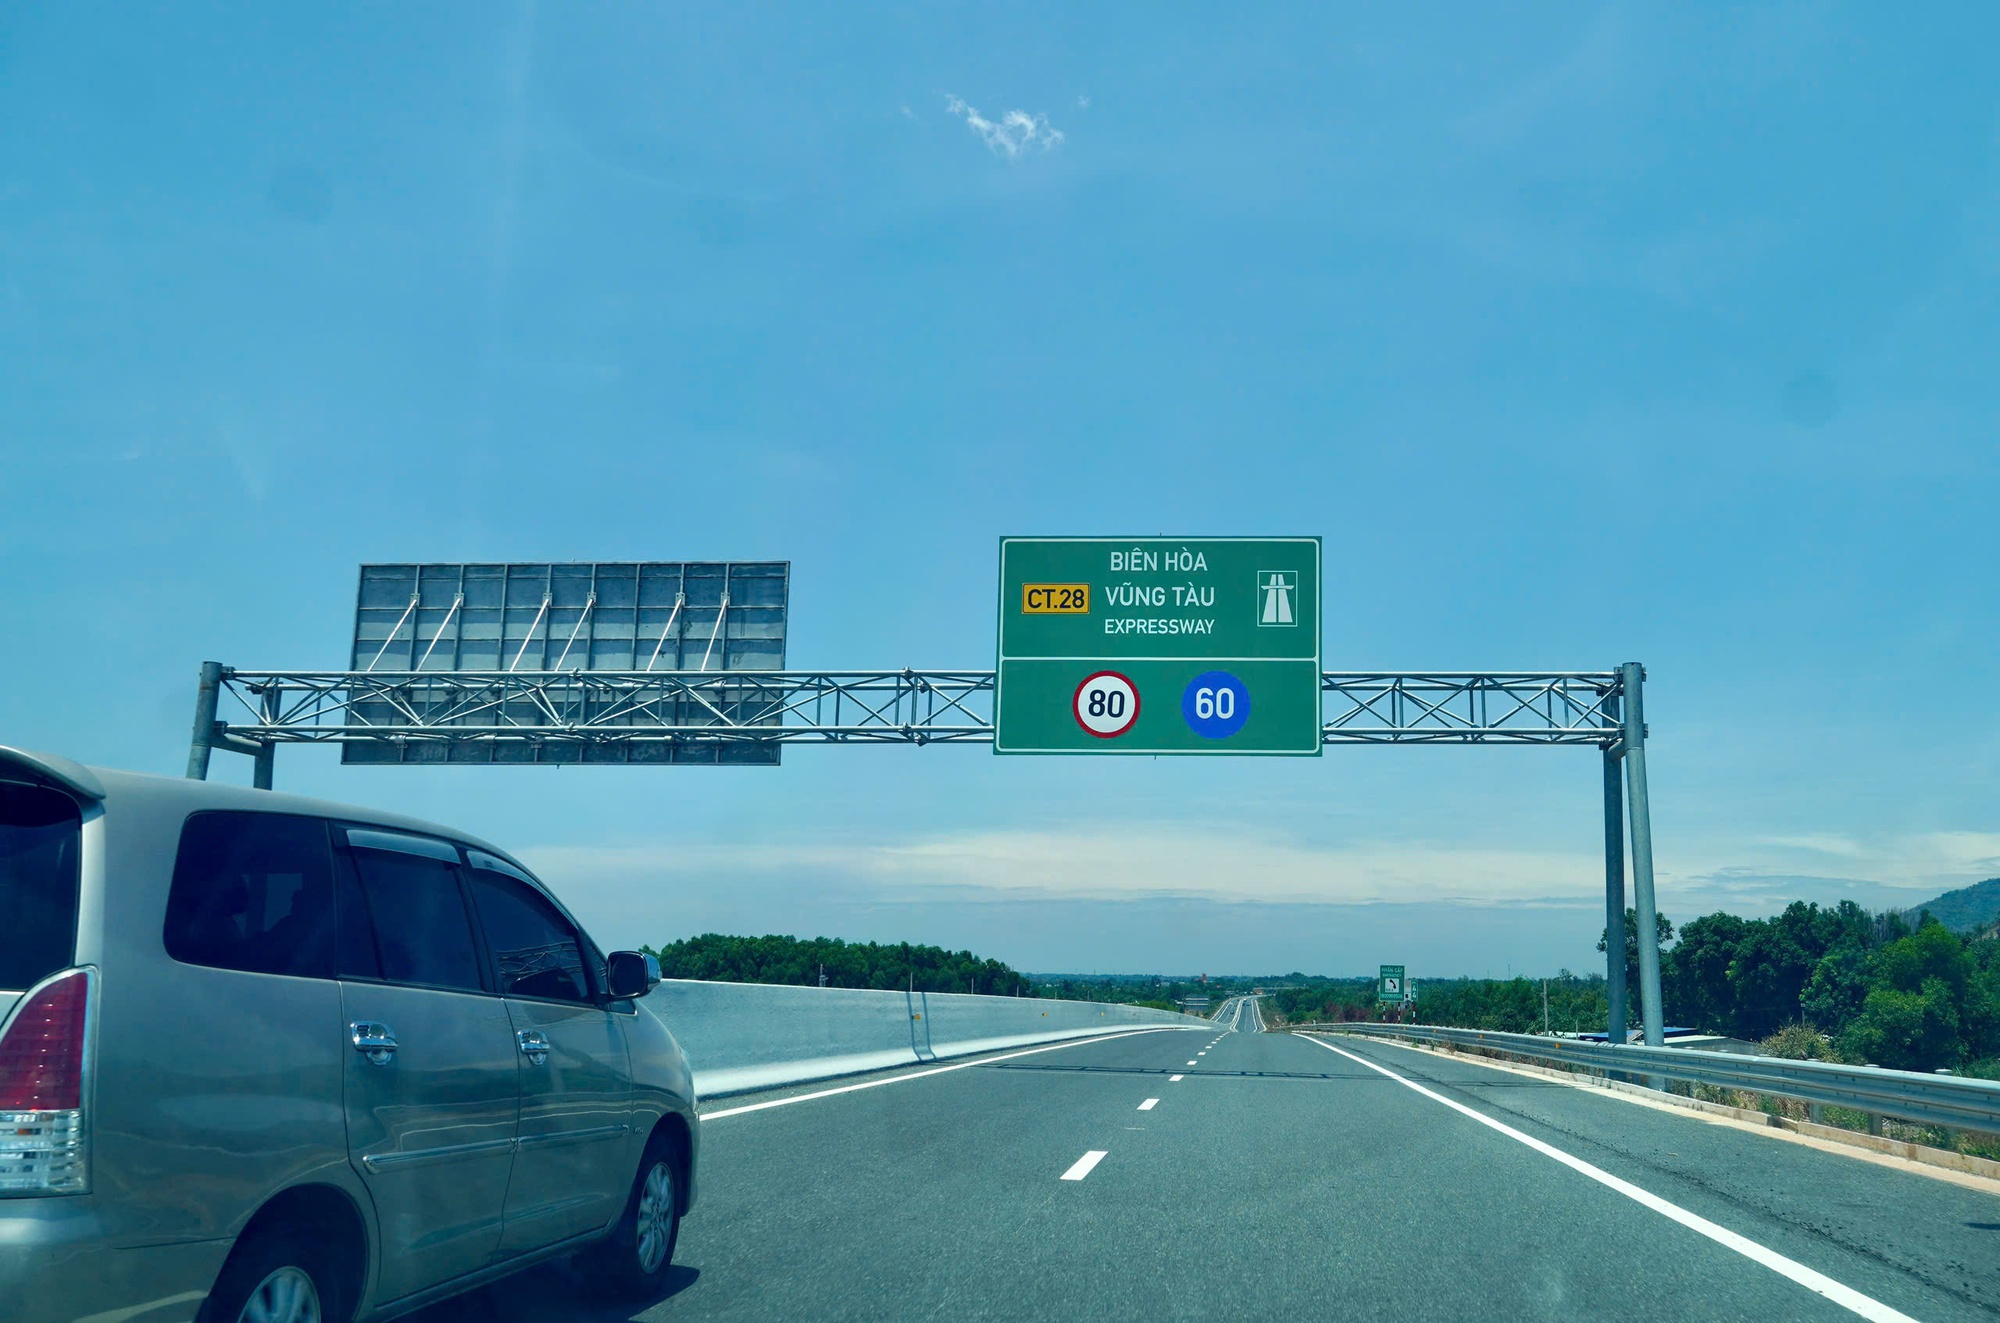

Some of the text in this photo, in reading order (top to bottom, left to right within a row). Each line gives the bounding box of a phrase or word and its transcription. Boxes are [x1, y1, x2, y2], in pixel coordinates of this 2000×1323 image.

[1110, 546, 1208, 572] BIÊN HÒA
[1027, 588, 1085, 609] CT.28
[1105, 582, 1215, 607] VŨNG TÀU
[1104, 618, 1215, 634] EXPRESSWAY
[1088, 689, 1125, 718] 80
[1195, 687, 1235, 719] 60
